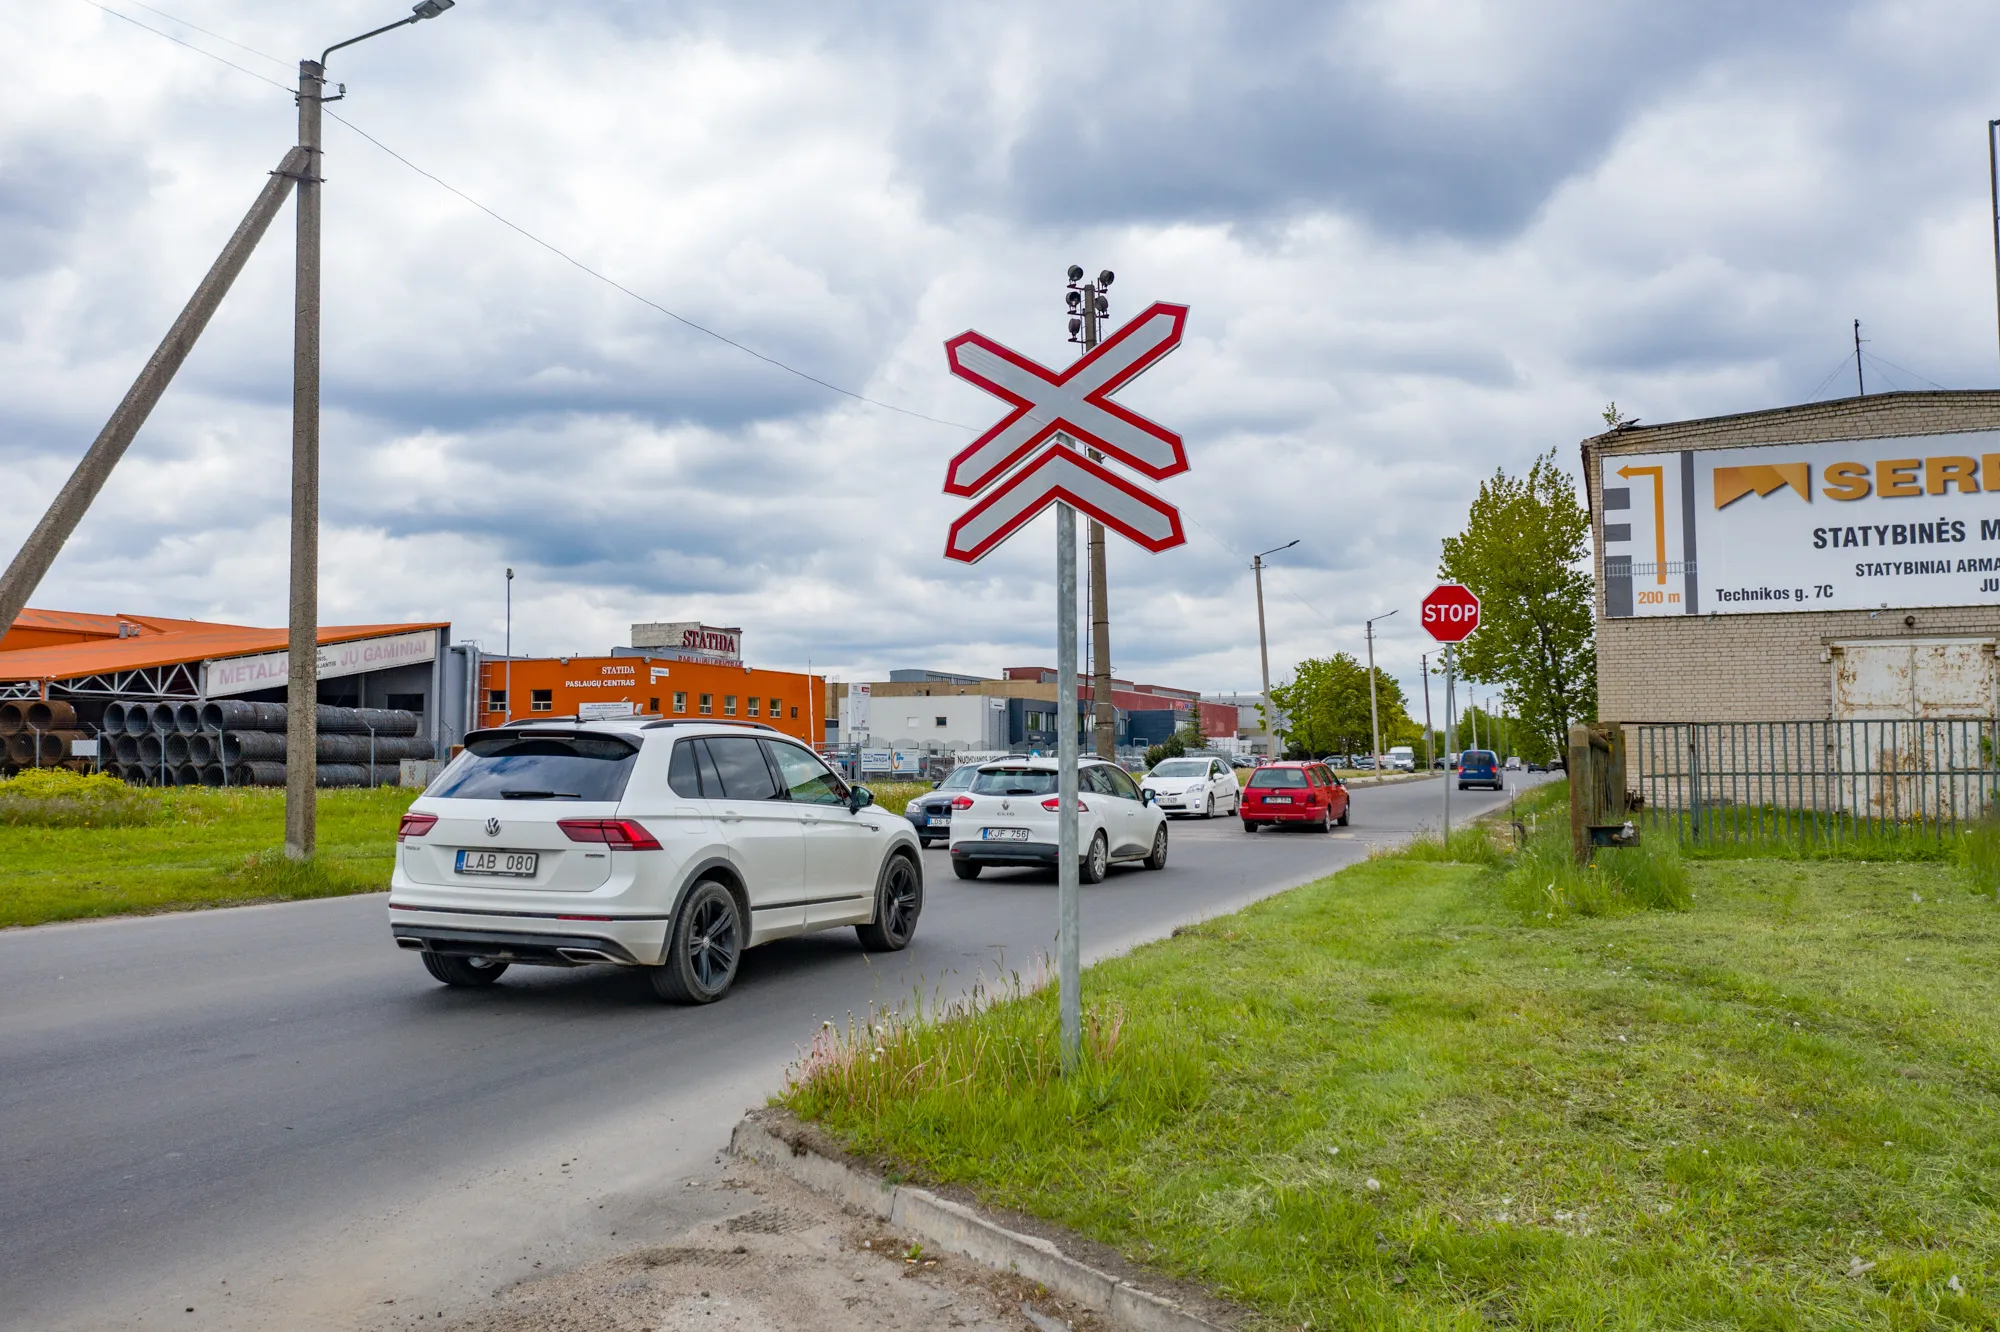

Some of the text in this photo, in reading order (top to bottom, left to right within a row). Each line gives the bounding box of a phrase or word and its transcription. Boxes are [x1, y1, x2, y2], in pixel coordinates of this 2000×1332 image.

[1813, 517, 1966, 549] STATYBINĖS
[1856, 560, 1951, 577] STATYBINIAI
[1638, 591, 1681, 605] 200 m
[1716, 584, 1834, 602] Technikos g. 7C
[1424, 604, 1477, 622] STOP
[683, 629, 736, 653] STATIDA
[363, 639, 428, 663] GAMINIAI
[219, 658, 288, 685] METALA
[601, 666, 636, 675] STATIDA
[565, 679, 636, 689] PASLAUGŲ CENTRAS
[988, 829, 1027, 838] KJF 756
[465, 852, 533, 871] LAB 080
